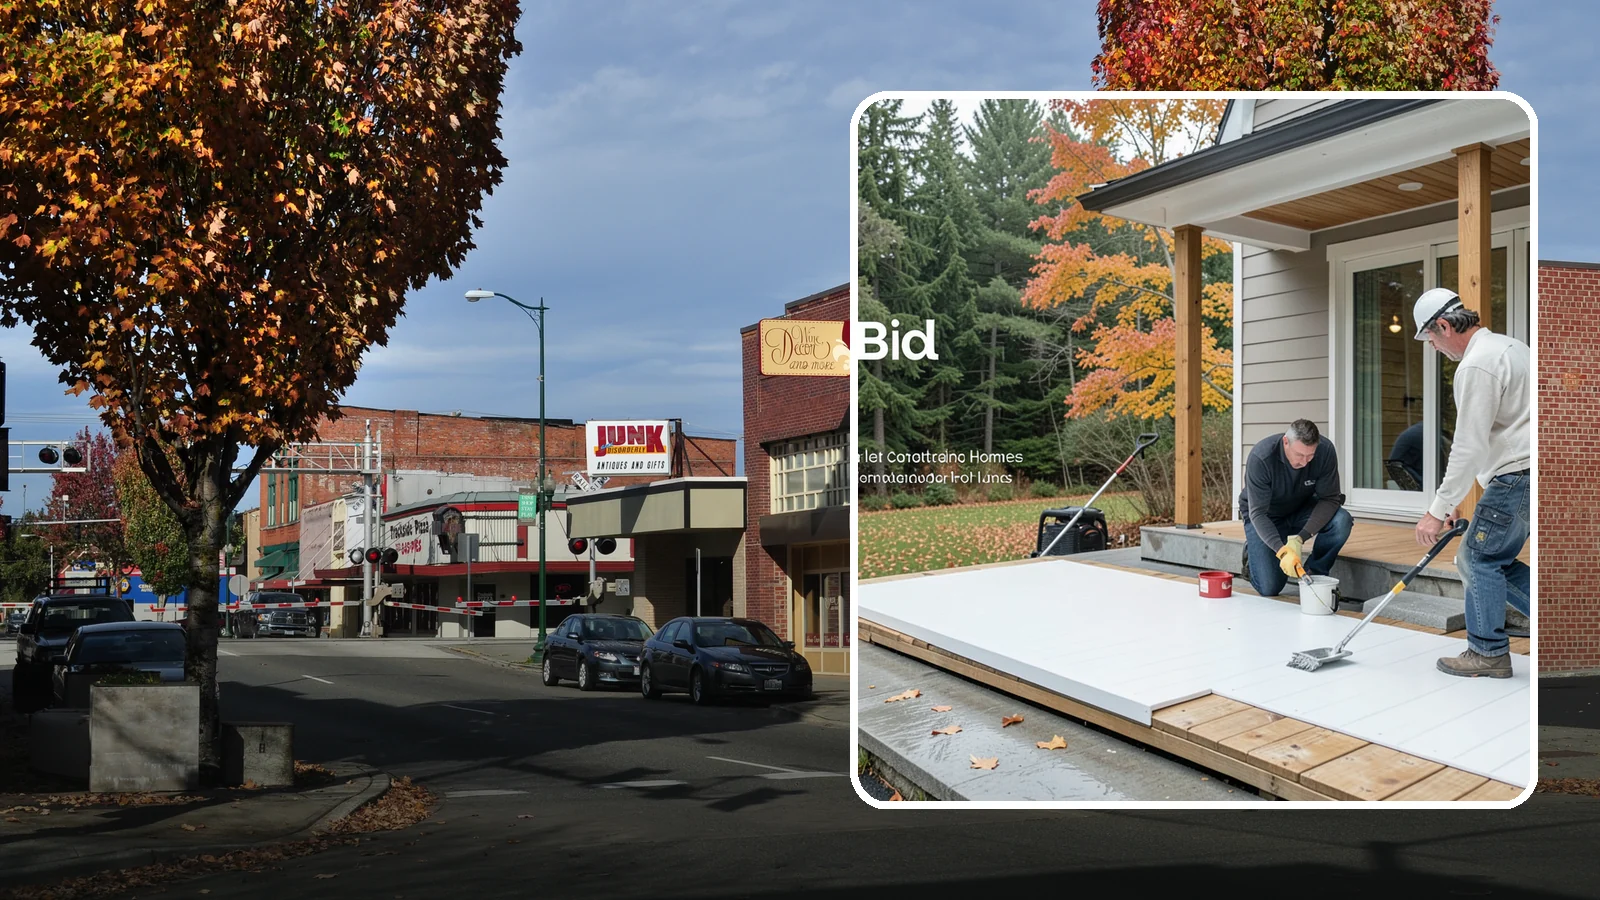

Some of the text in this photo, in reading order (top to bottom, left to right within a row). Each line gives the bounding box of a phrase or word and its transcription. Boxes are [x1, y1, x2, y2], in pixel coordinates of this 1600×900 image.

[765, 327, 831, 365] Decor
[595, 425, 665, 457] JUNK
[607, 446, 646, 454] DISORDERLY
[596, 460, 665, 470] ANTIQUES AND GIFTS
[414, 519, 429, 535] Pizza
